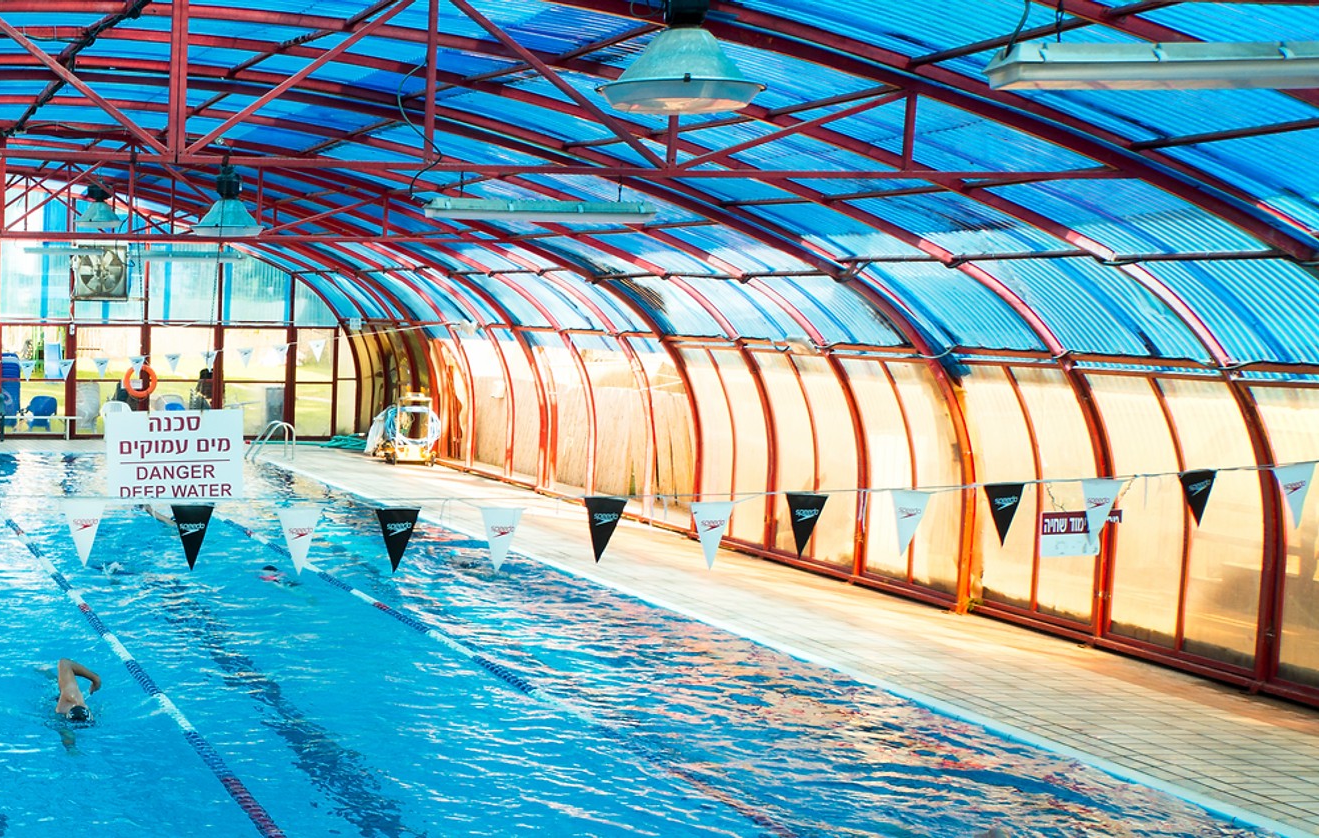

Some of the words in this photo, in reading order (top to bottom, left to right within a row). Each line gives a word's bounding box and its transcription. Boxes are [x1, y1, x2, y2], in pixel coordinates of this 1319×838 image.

[149, 416, 201, 432] סכנה
[119, 439, 188, 459] עמוקים
[196, 437, 231, 453] מים
[136, 464, 215, 481] DANGER
[120, 485, 166, 498] DEEP
[171, 483, 232, 498] WATER
[994, 496, 1018, 506] speedo
[795, 508, 819, 517] speedo
[899, 507, 922, 515] speedo
[72, 518, 99, 527] speedo
[593, 512, 619, 523] speedo
[179, 522, 205, 531] speedo
[386, 522, 412, 532] speedo
[701, 518, 725, 528] speedo
[1043, 517, 1068, 533] שחיה
[288, 527, 313, 536] speedo
[491, 525, 515, 535] speedo
